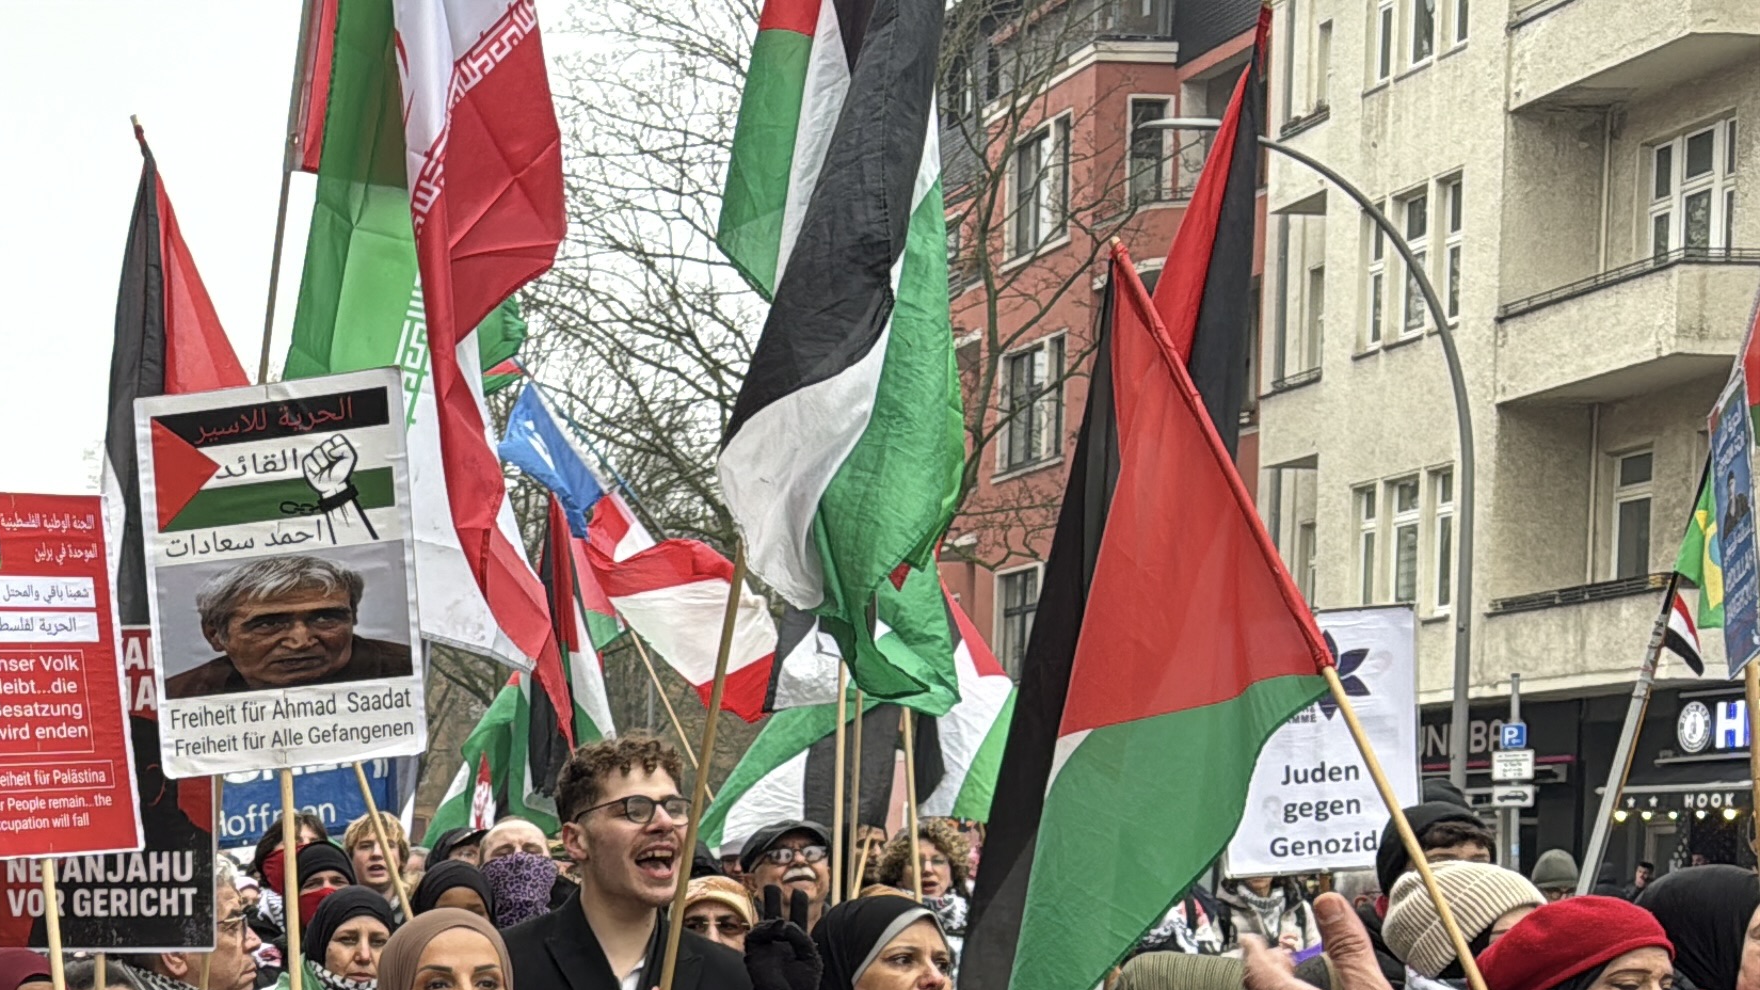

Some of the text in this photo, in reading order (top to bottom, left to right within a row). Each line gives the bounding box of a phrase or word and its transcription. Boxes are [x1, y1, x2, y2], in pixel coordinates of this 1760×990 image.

[278, 397, 353, 432] الحرية
[215, 448, 298, 481] القائد
[165, 519, 321, 560] احمد سعادات
[3, 584, 39, 602] والمحتل
[43, 585, 63, 604] باقي
[65, 585, 89, 601] شعبنا
[40, 618, 76, 636] الحرية
[40, 655, 79, 671] Volk
[170, 686, 411, 731] Freiheit für Ahmad Saadat
[36, 723, 88, 739] enden
[174, 719, 414, 757] Freiheit für Alle Gefangenen
[1504, 727, 1519, 746] P
[34, 770, 50, 785] für
[53, 769, 105, 785] Palästina
[1280, 763, 1360, 787] Juden
[8, 796, 46, 813] People
[1283, 797, 1361, 824] gegen
[52, 814, 70, 828] will
[72, 812, 90, 827] fall
[1269, 830, 1378, 858] Genozid
[73, 887, 198, 917] GERICHT
